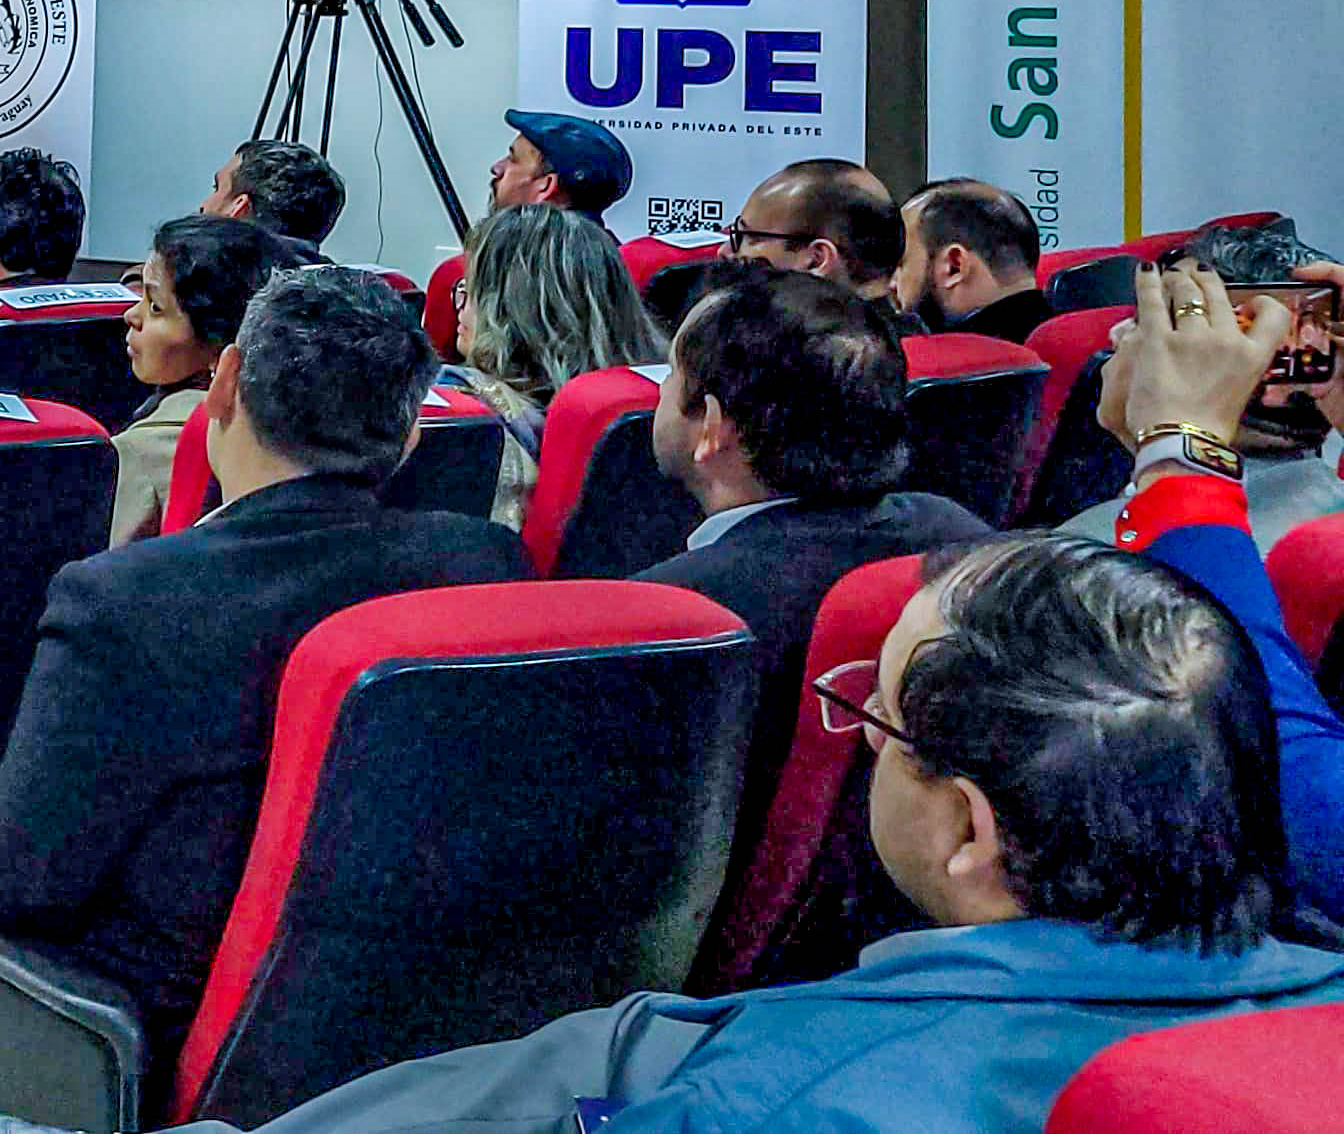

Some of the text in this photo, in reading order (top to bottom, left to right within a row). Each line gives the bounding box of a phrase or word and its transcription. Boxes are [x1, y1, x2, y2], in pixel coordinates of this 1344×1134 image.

[564, 26, 822, 114] UPE
[990, 7, 1059, 140] San
[672, 122, 737, 133] PRIVADA
[746, 124, 774, 134] DEL
[783, 126, 822, 136] ESTE
